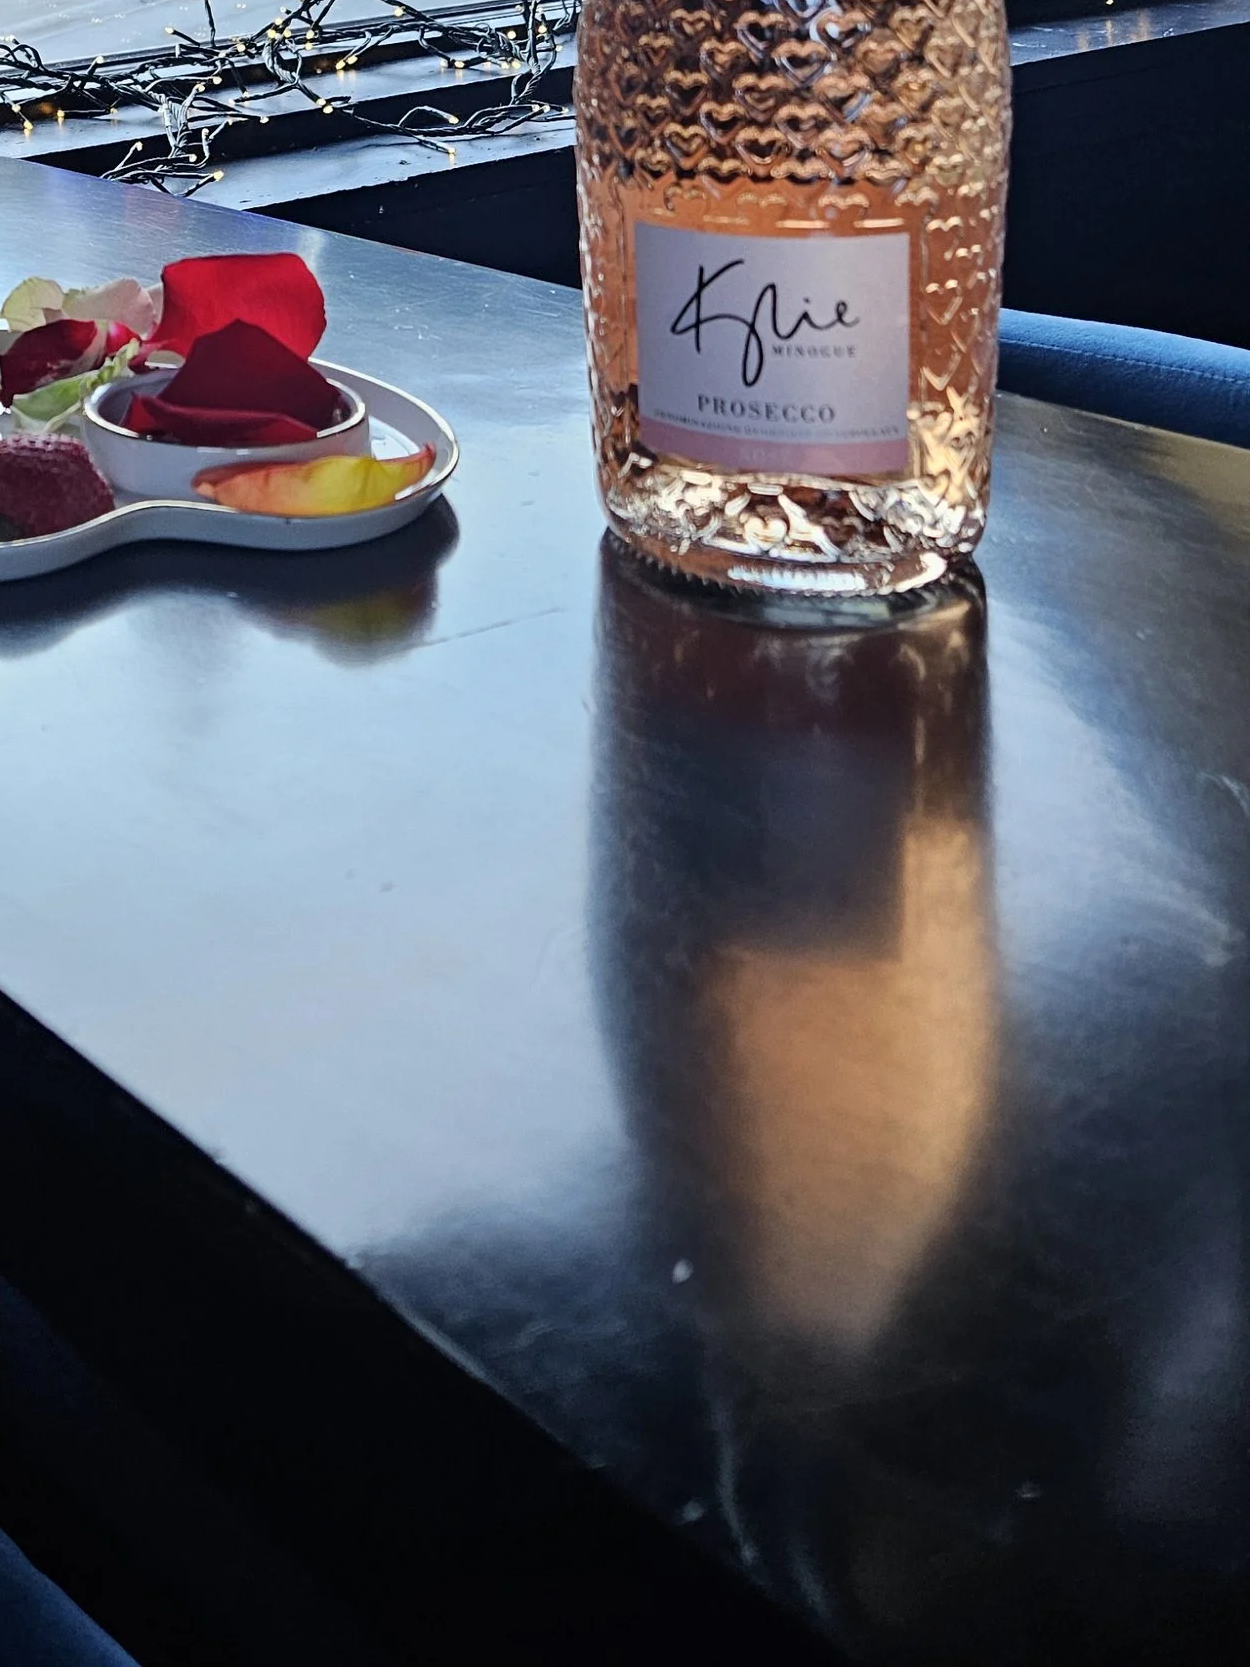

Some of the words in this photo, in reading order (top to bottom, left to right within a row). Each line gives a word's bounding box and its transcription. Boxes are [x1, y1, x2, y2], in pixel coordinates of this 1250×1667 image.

[670, 258, 861, 387] Kylie
[771, 344, 857, 358] MINOGUE
[697, 393, 836, 425] PROSECCO
